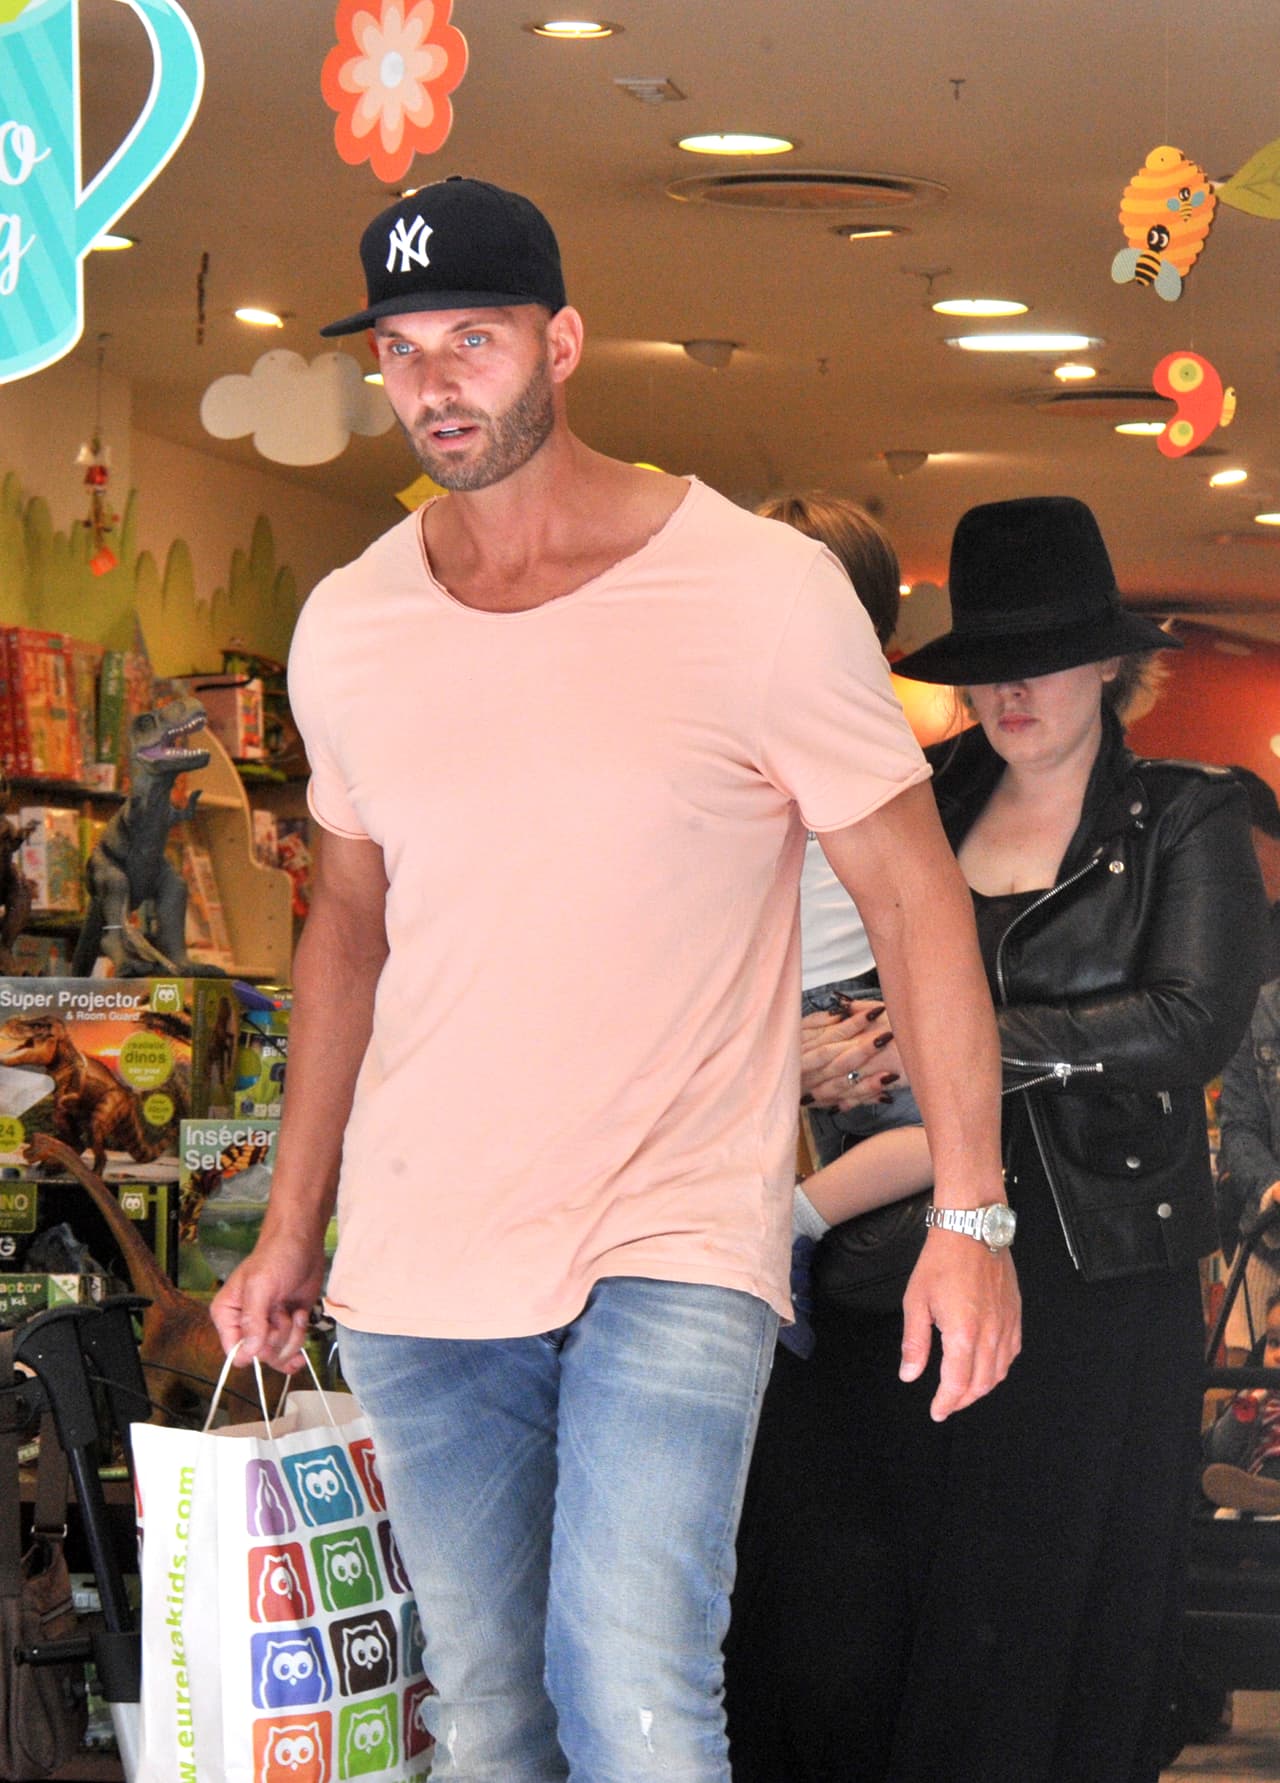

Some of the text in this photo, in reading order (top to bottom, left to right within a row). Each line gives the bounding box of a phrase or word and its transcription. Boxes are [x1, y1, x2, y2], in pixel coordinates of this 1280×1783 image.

[385, 213, 434, 273] NY
[0, 991, 140, 1012] Super Projector
[125, 1051, 166, 1063] dinos
